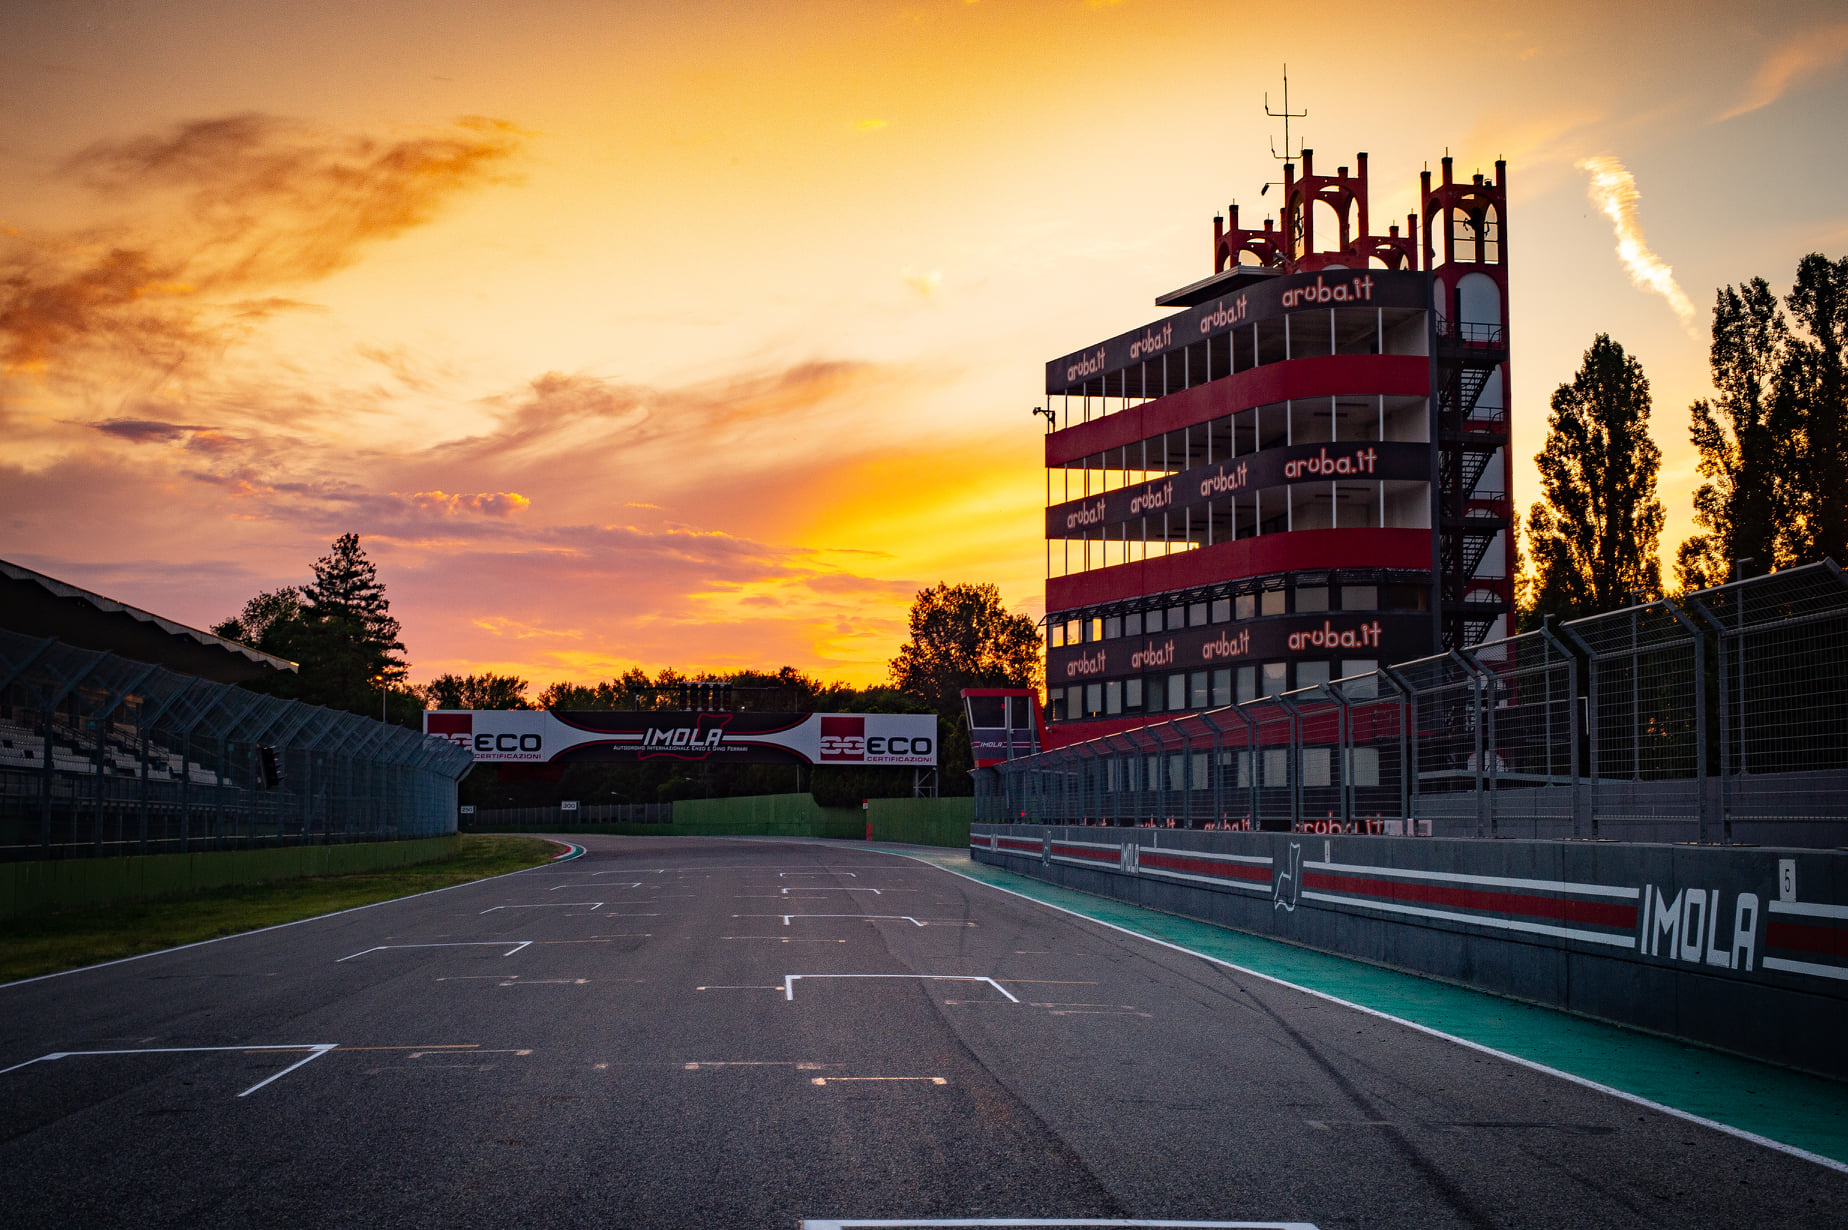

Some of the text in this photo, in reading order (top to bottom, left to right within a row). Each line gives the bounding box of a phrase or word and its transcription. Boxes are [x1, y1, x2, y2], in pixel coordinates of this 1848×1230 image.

[1282, 275, 1374, 308] aruba.it
[1200, 294, 1248, 333] aruba.it
[1130, 321, 1173, 359] aruba.it
[1067, 347, 1105, 381] aruba.it
[1284, 447, 1377, 478] aruba.it
[1200, 461, 1248, 497] aruba.it
[1130, 480, 1173, 514] aruba.it
[1067, 498, 1106, 529] aruba.it
[1202, 628, 1250, 660] aruba.it
[1288, 620, 1382, 650] aruba.it
[1067, 649, 1106, 677] aruba.it
[1131, 639, 1175, 669] aruba.it
[475, 734, 541, 751] ECO
[643, 727, 723, 746] IMOLA
[867, 737, 932, 755] ECO
[1784, 868, 1791, 893] 5
[1640, 883, 1759, 971] IMOLA
